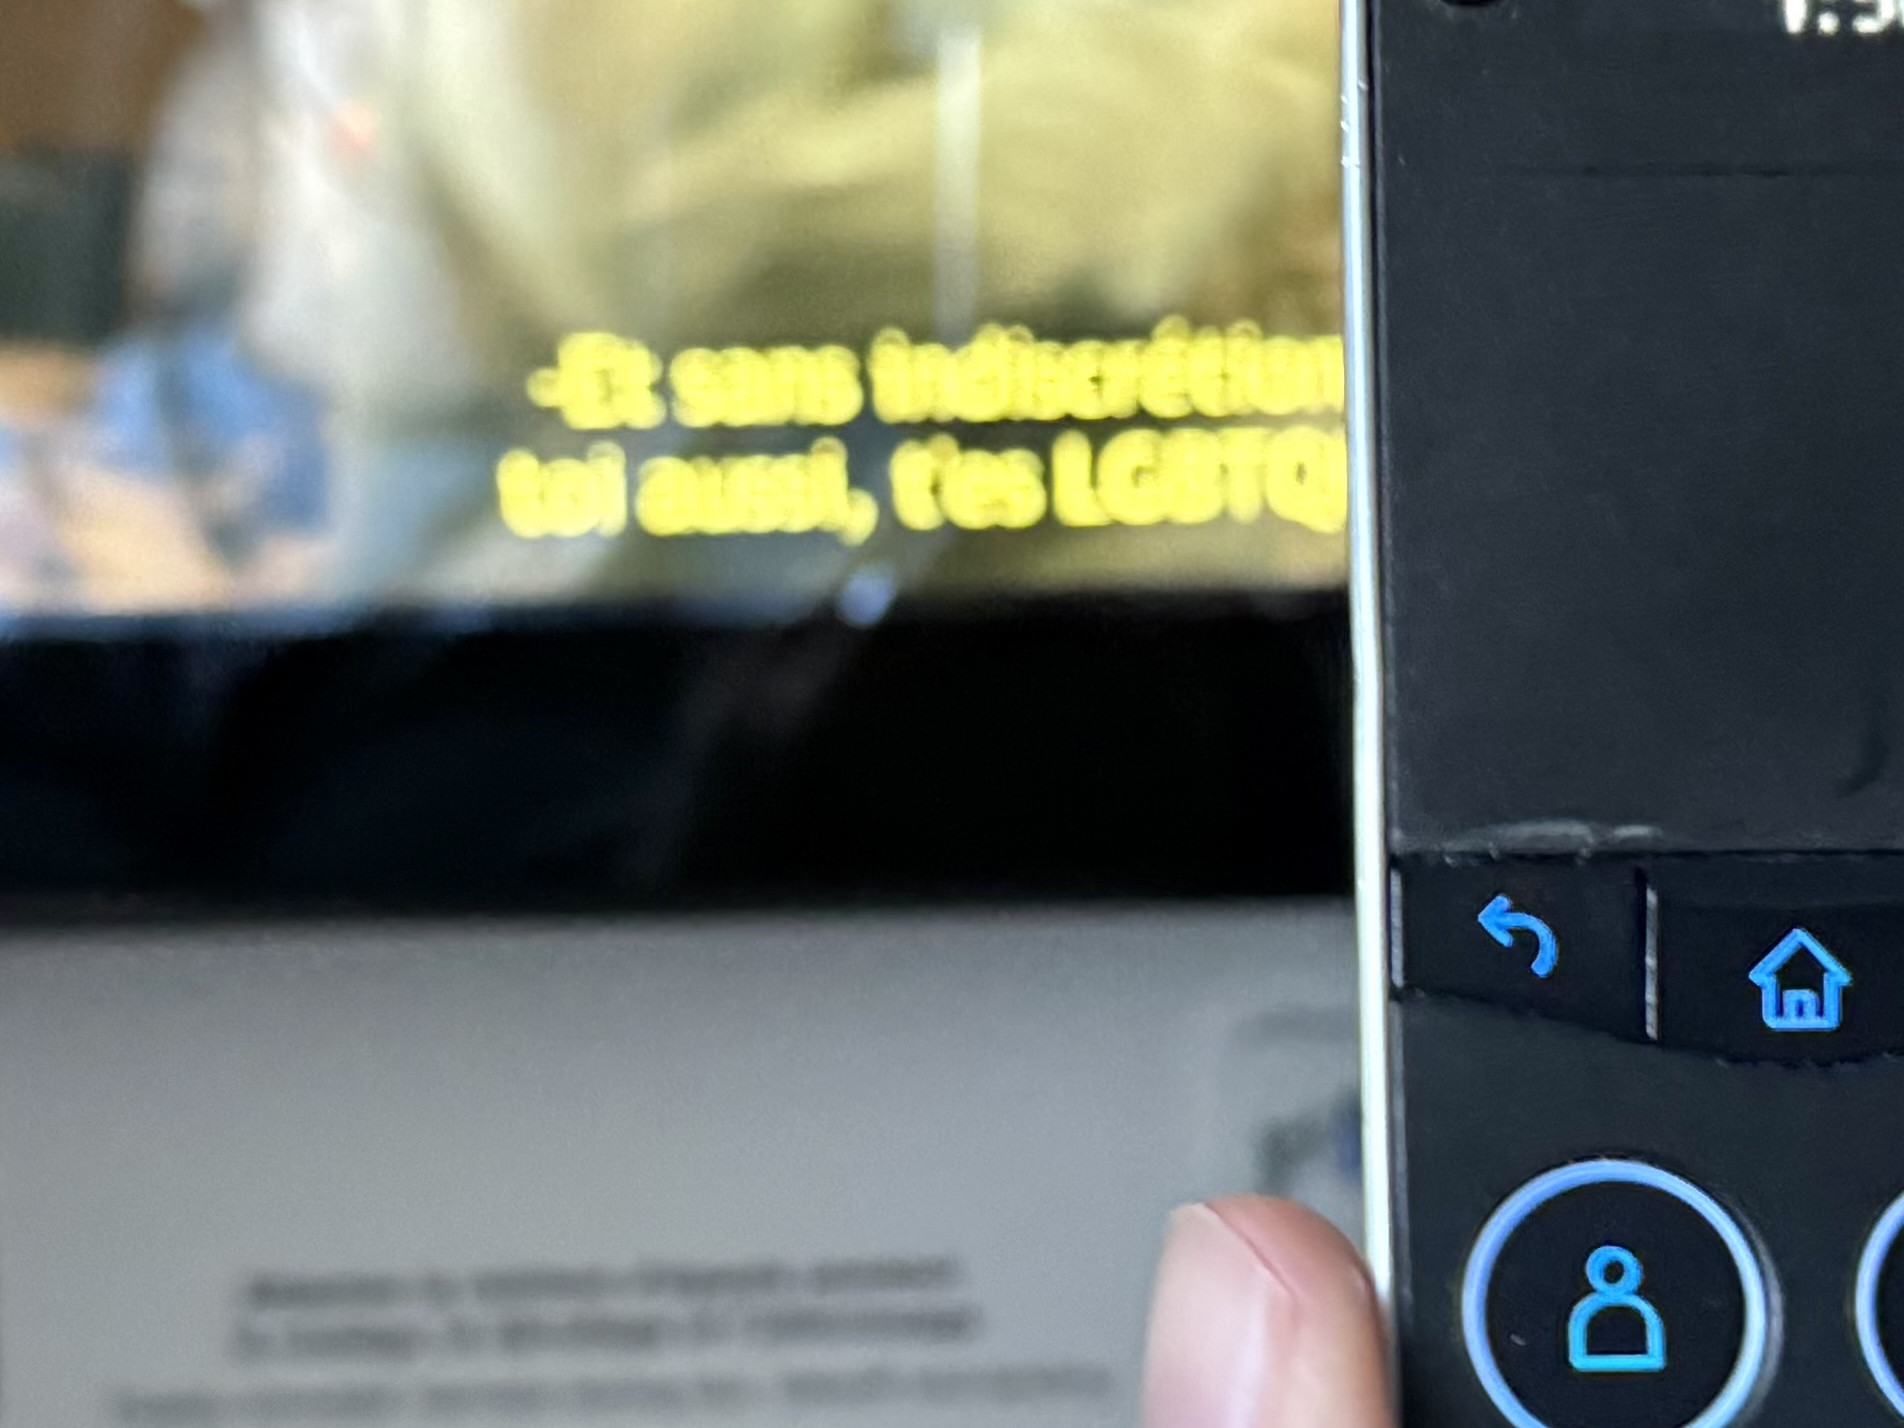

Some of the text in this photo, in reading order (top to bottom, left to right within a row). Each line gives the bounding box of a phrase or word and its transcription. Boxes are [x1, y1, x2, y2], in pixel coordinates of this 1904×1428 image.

[668, 345, 863, 426] sans
[496, 441, 627, 538] toi
[635, 437, 879, 546] aussi,
